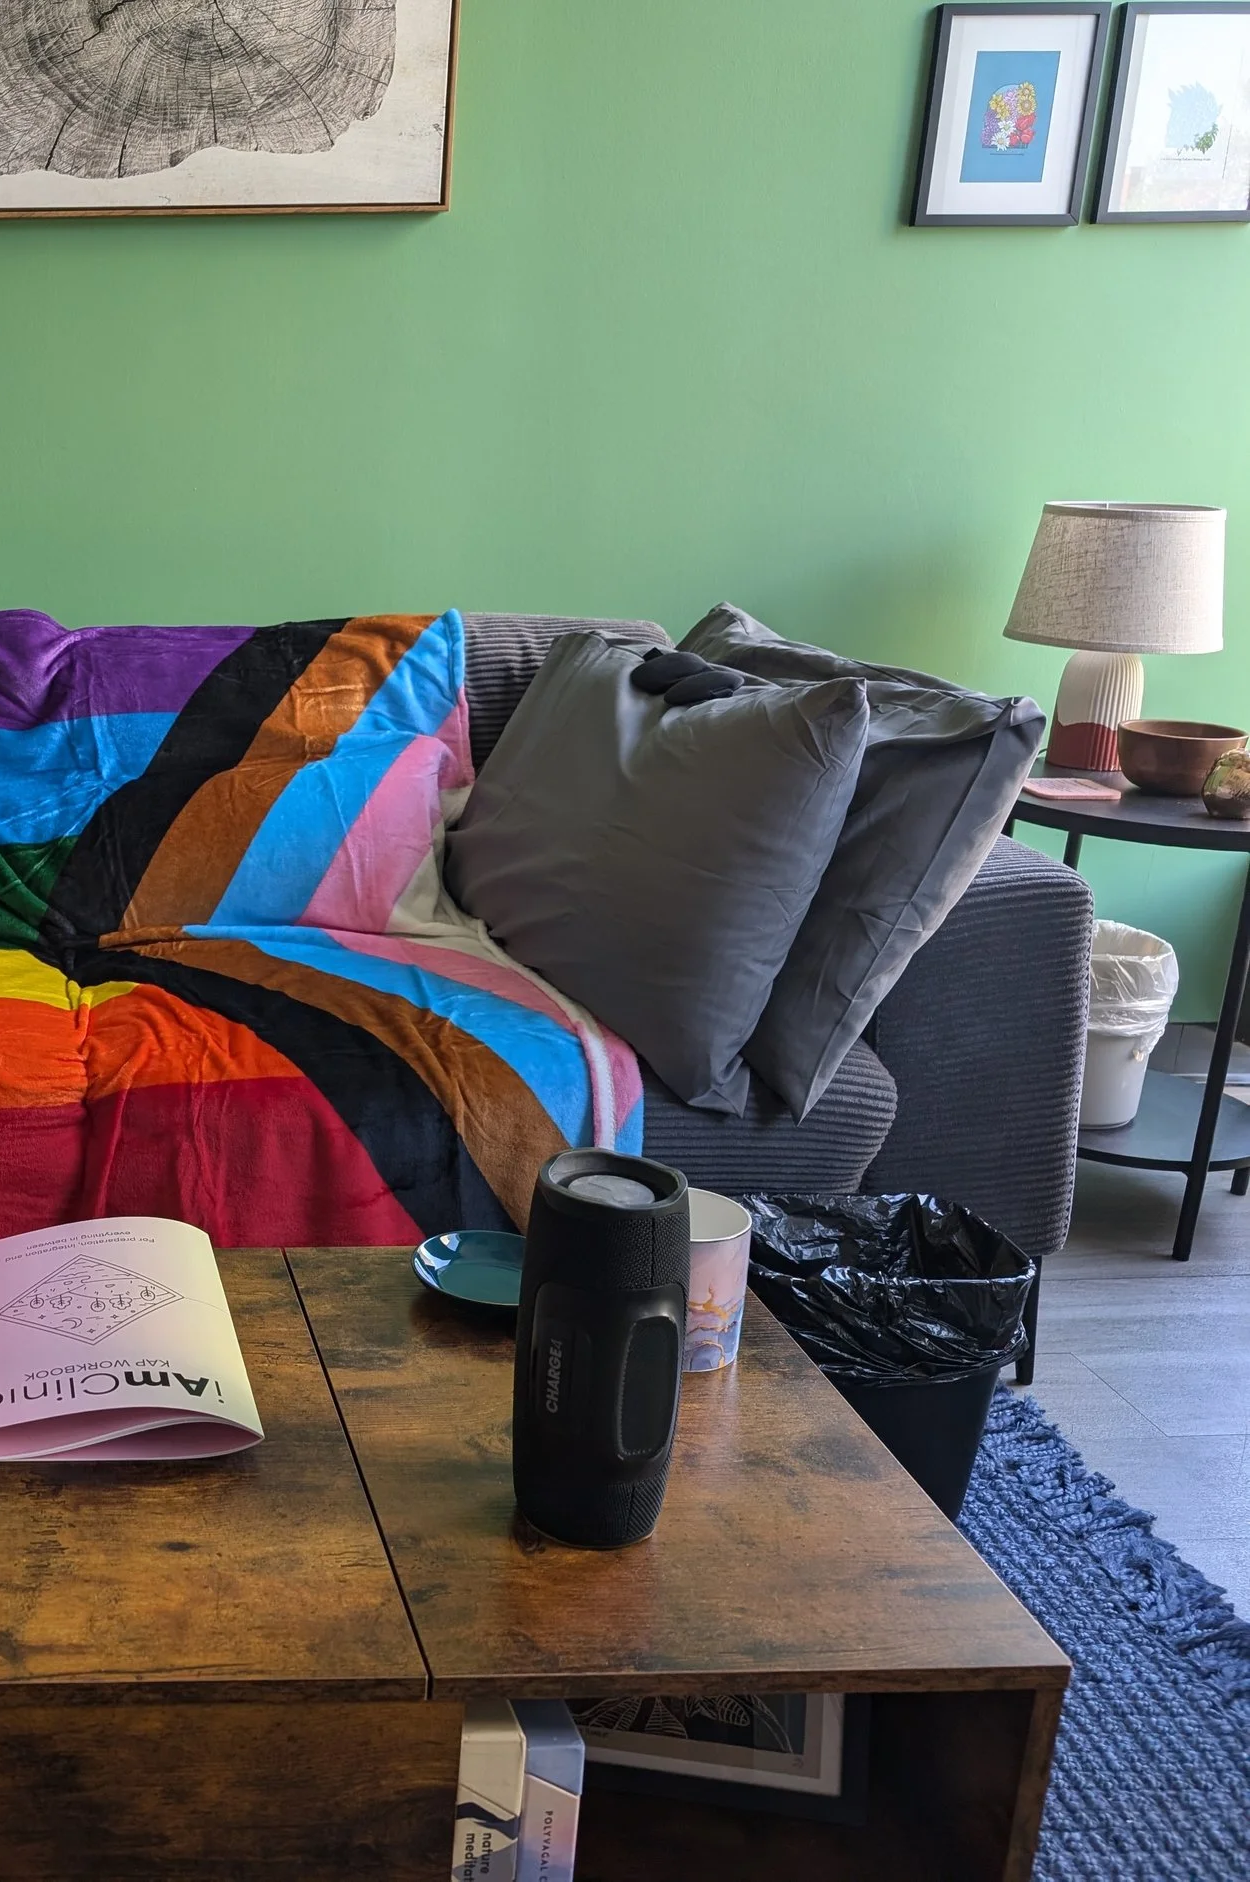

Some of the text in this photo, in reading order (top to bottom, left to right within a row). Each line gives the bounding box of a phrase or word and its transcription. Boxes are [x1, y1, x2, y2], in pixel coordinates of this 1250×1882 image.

[81, 1230, 131, 1240] everything
[26, 1237, 67, 1250] between
[78, 1237, 136, 1247] preparation,
[26, 1244, 76, 1257] integration
[5, 1253, 23, 1263] and
[24, 1358, 170, 1382] KAP WORKBOOK
[540, 1810, 554, 1872] POLYVAGAL
[480, 1832, 493, 1874] nature
